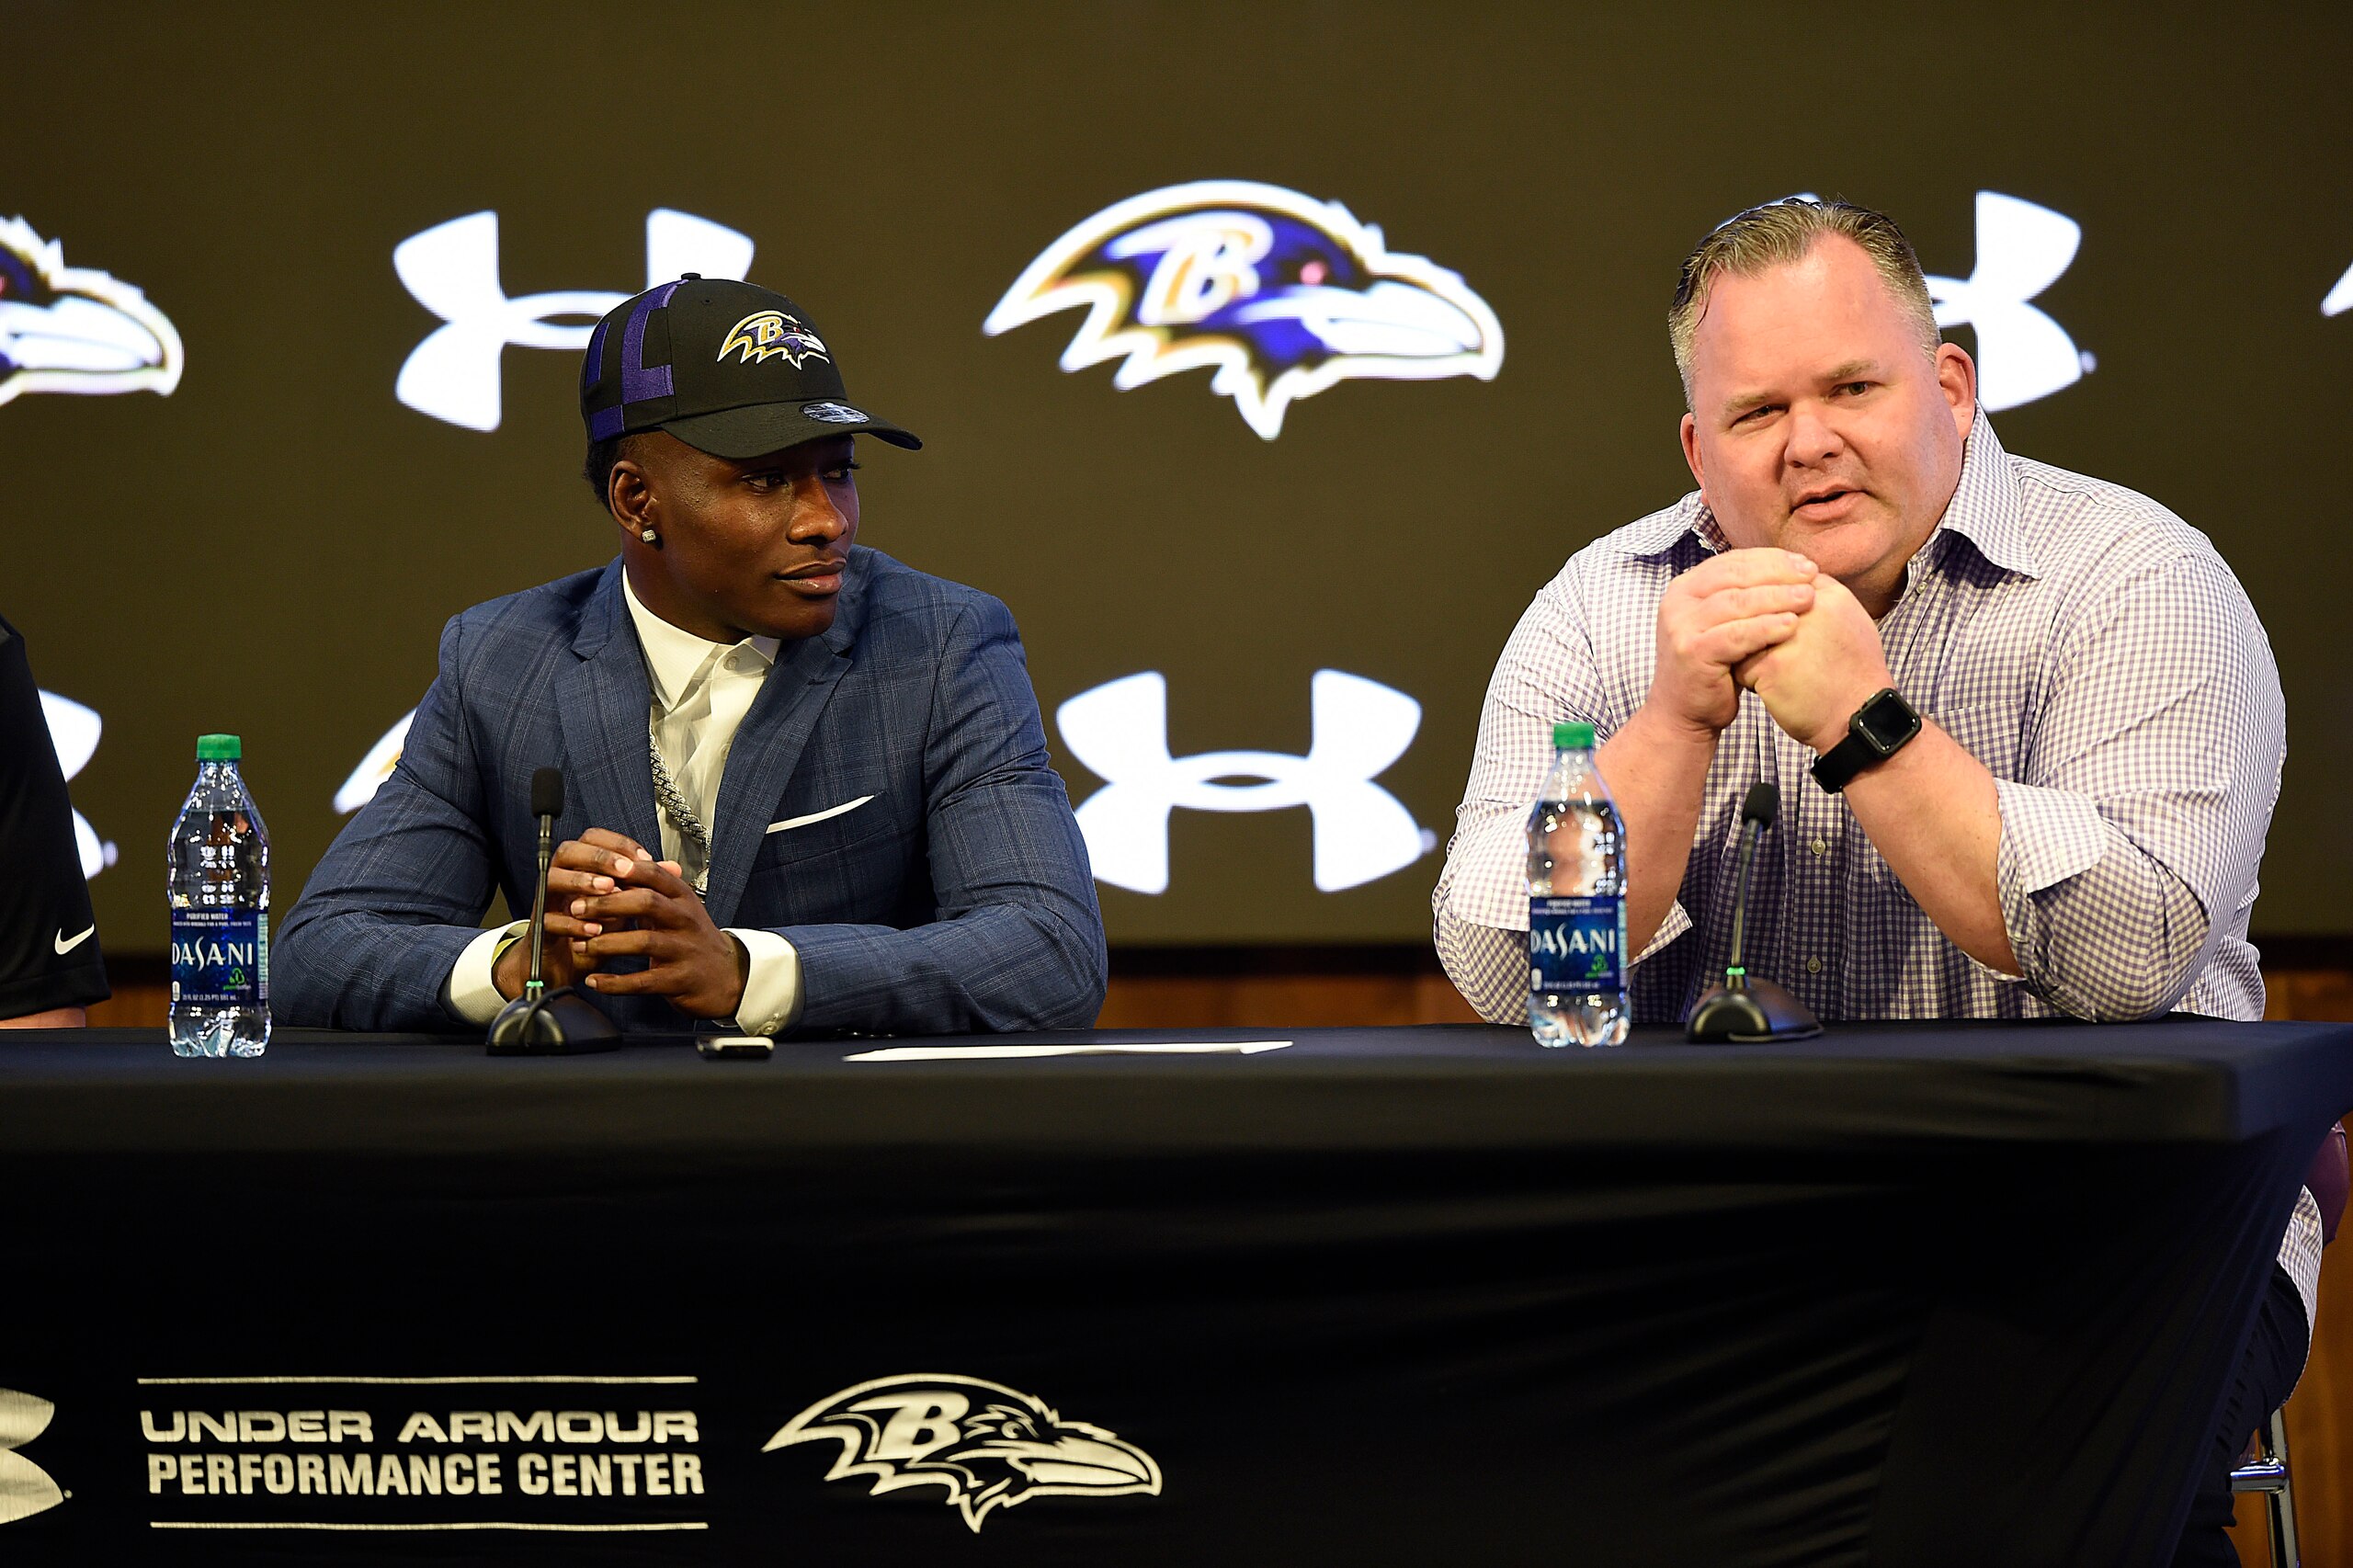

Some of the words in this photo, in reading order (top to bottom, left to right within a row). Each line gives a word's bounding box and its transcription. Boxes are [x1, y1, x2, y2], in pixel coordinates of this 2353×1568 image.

[172, 936, 253, 971] DASANI
[1530, 922, 1615, 960] DASANI
[140, 1410, 374, 1444] UNDER
[397, 1410, 698, 1443] ARMOUR
[148, 1452, 503, 1495] PERFORMANCE
[517, 1452, 705, 1494] CENTER
